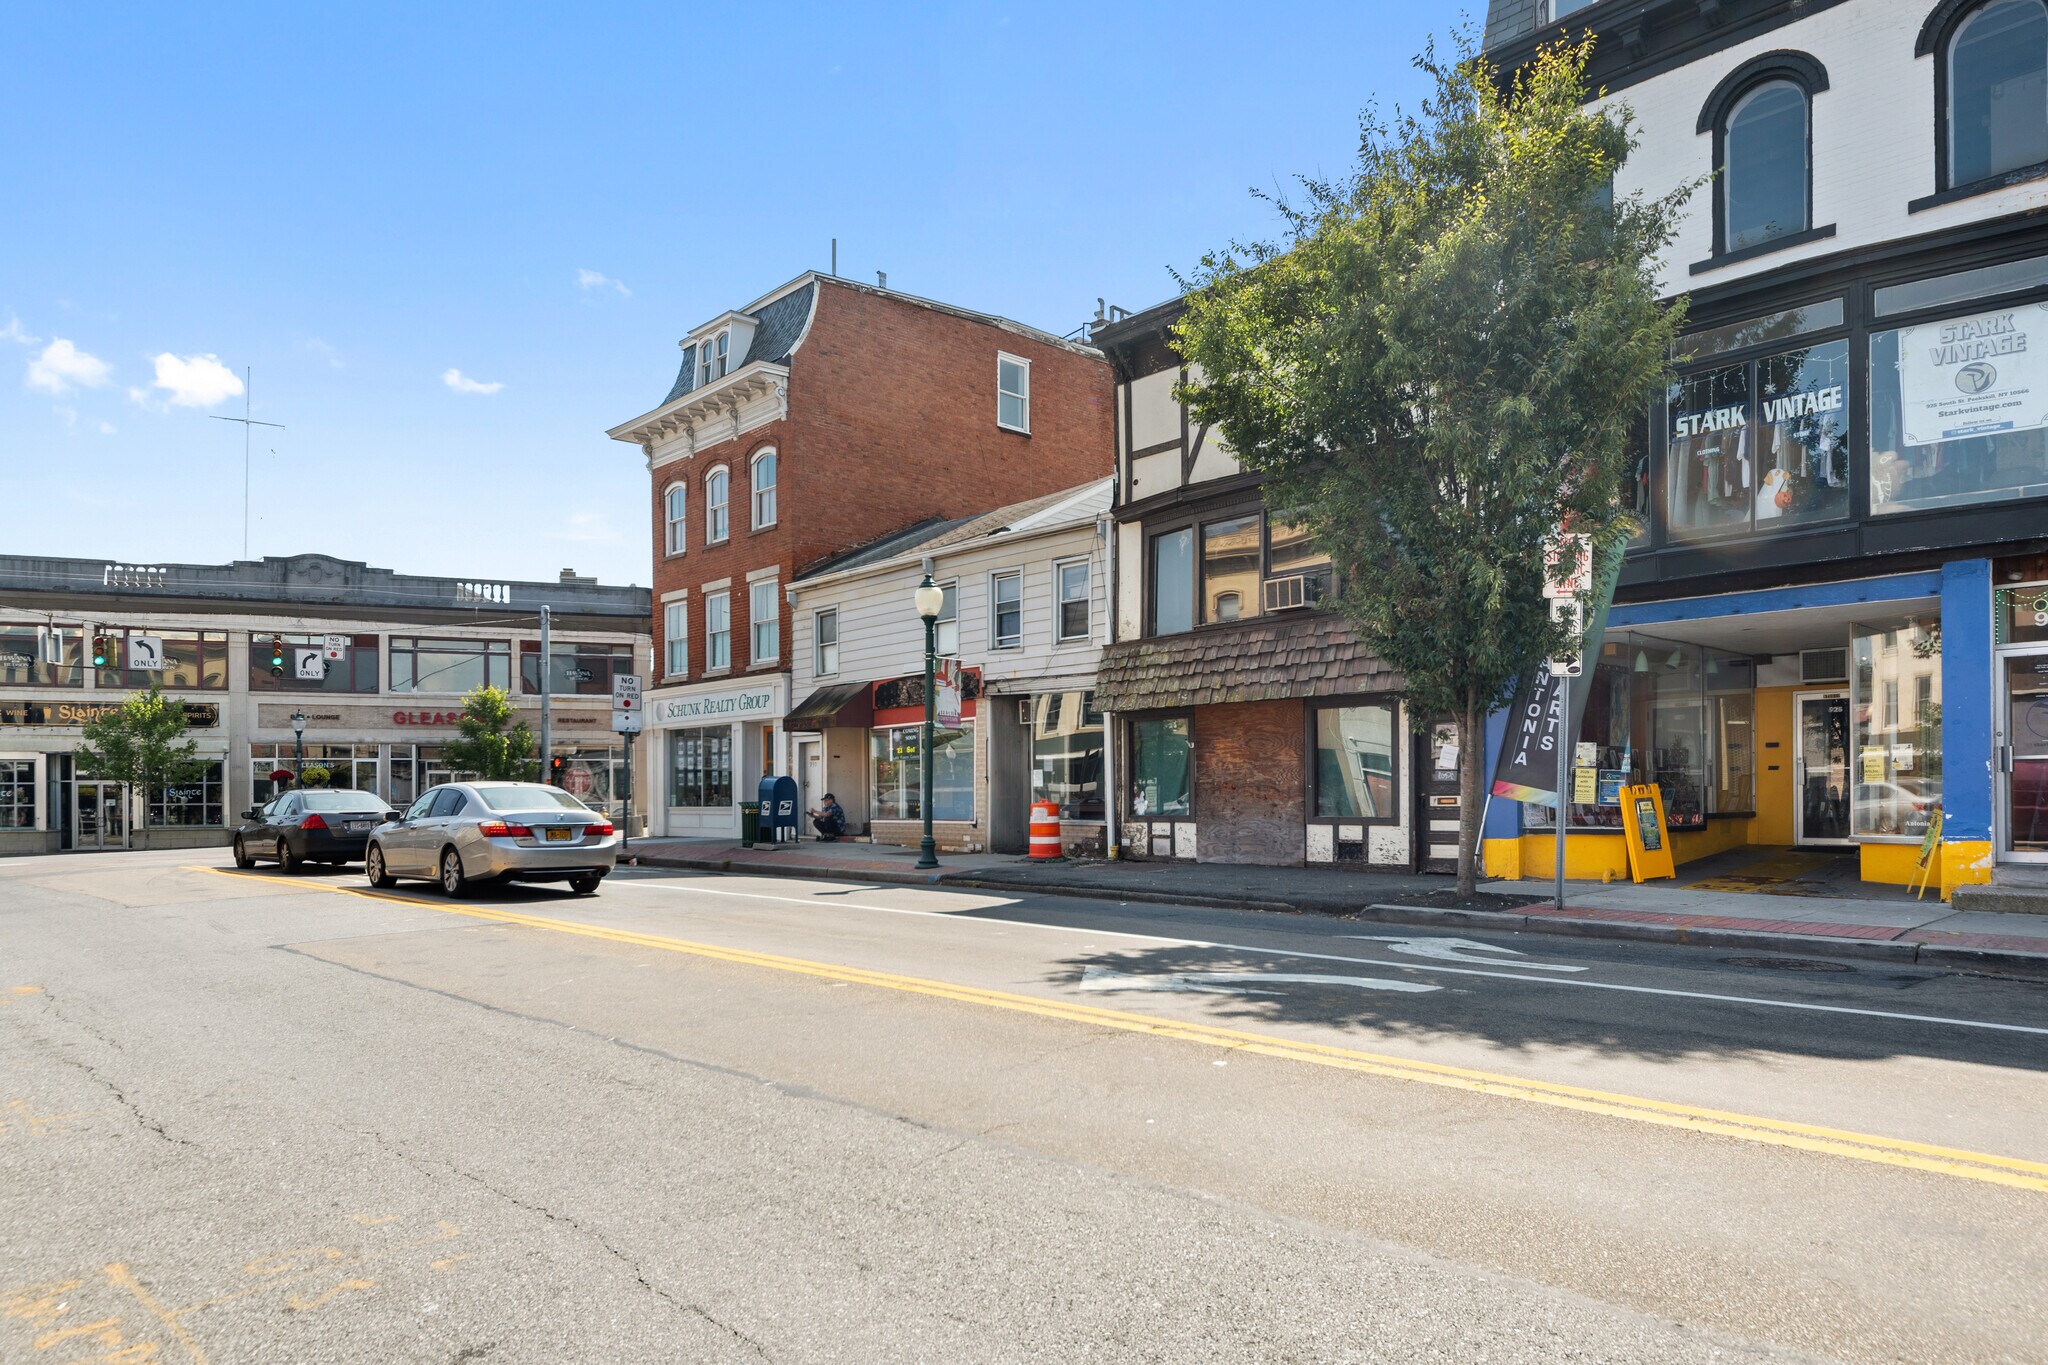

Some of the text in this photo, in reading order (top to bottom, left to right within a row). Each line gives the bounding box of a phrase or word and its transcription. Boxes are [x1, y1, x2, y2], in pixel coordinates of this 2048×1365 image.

[1941, 314, 2016, 344] STARK
[1929, 332, 2027, 366] VINTAGE
[1676, 385, 1842, 438] STARK VINTAGE
[1938, 400, 2023, 418] Starkvintage.com
[134, 659, 158, 667] ONLY
[621, 677, 634, 685] NO
[5, 709, 29, 717] WINE
[667, 693, 770, 718] SCHUNK REALTY GROUP
